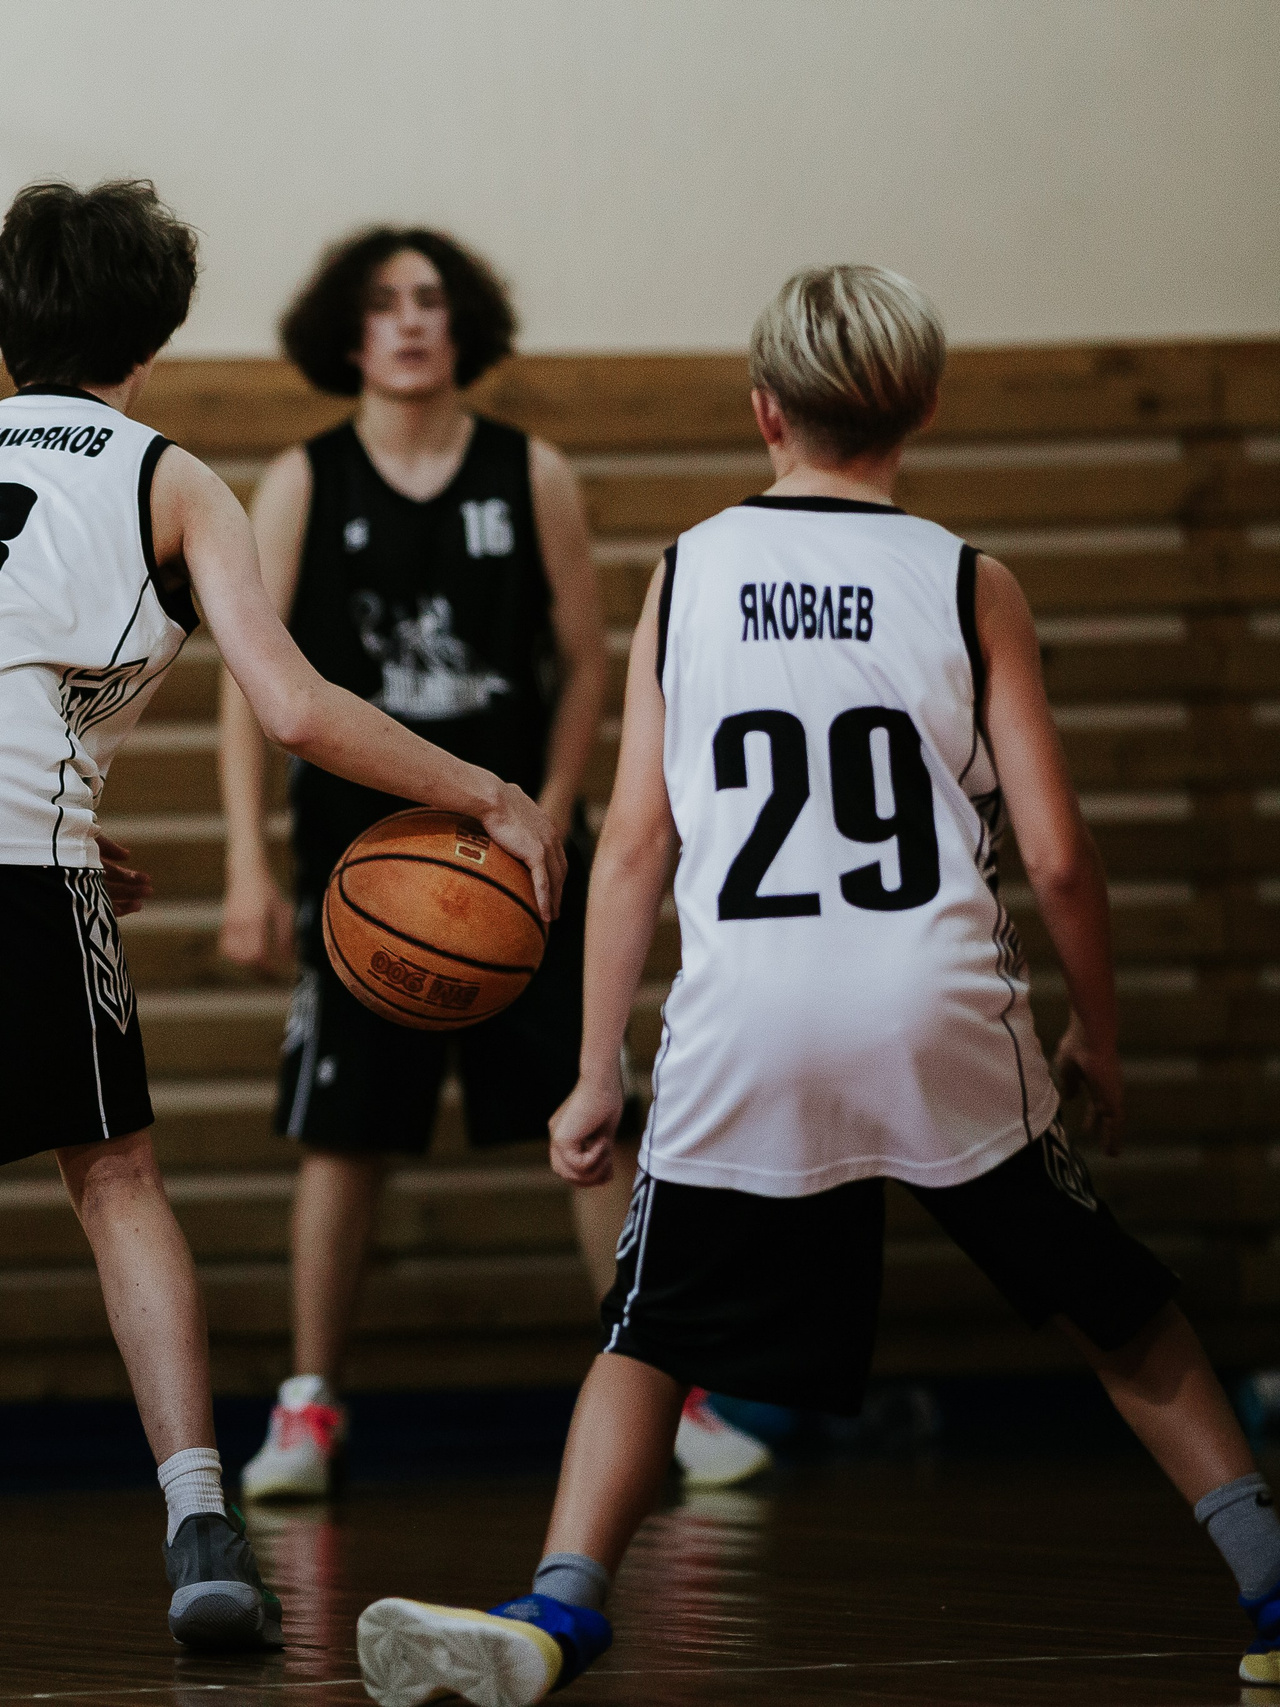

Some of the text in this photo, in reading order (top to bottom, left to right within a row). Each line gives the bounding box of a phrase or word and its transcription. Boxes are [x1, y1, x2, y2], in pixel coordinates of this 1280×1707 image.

[460, 499, 515, 558] 16
[740, 581, 874, 642] ЯКОВЛЕВ
[712, 706, 941, 921] 29
